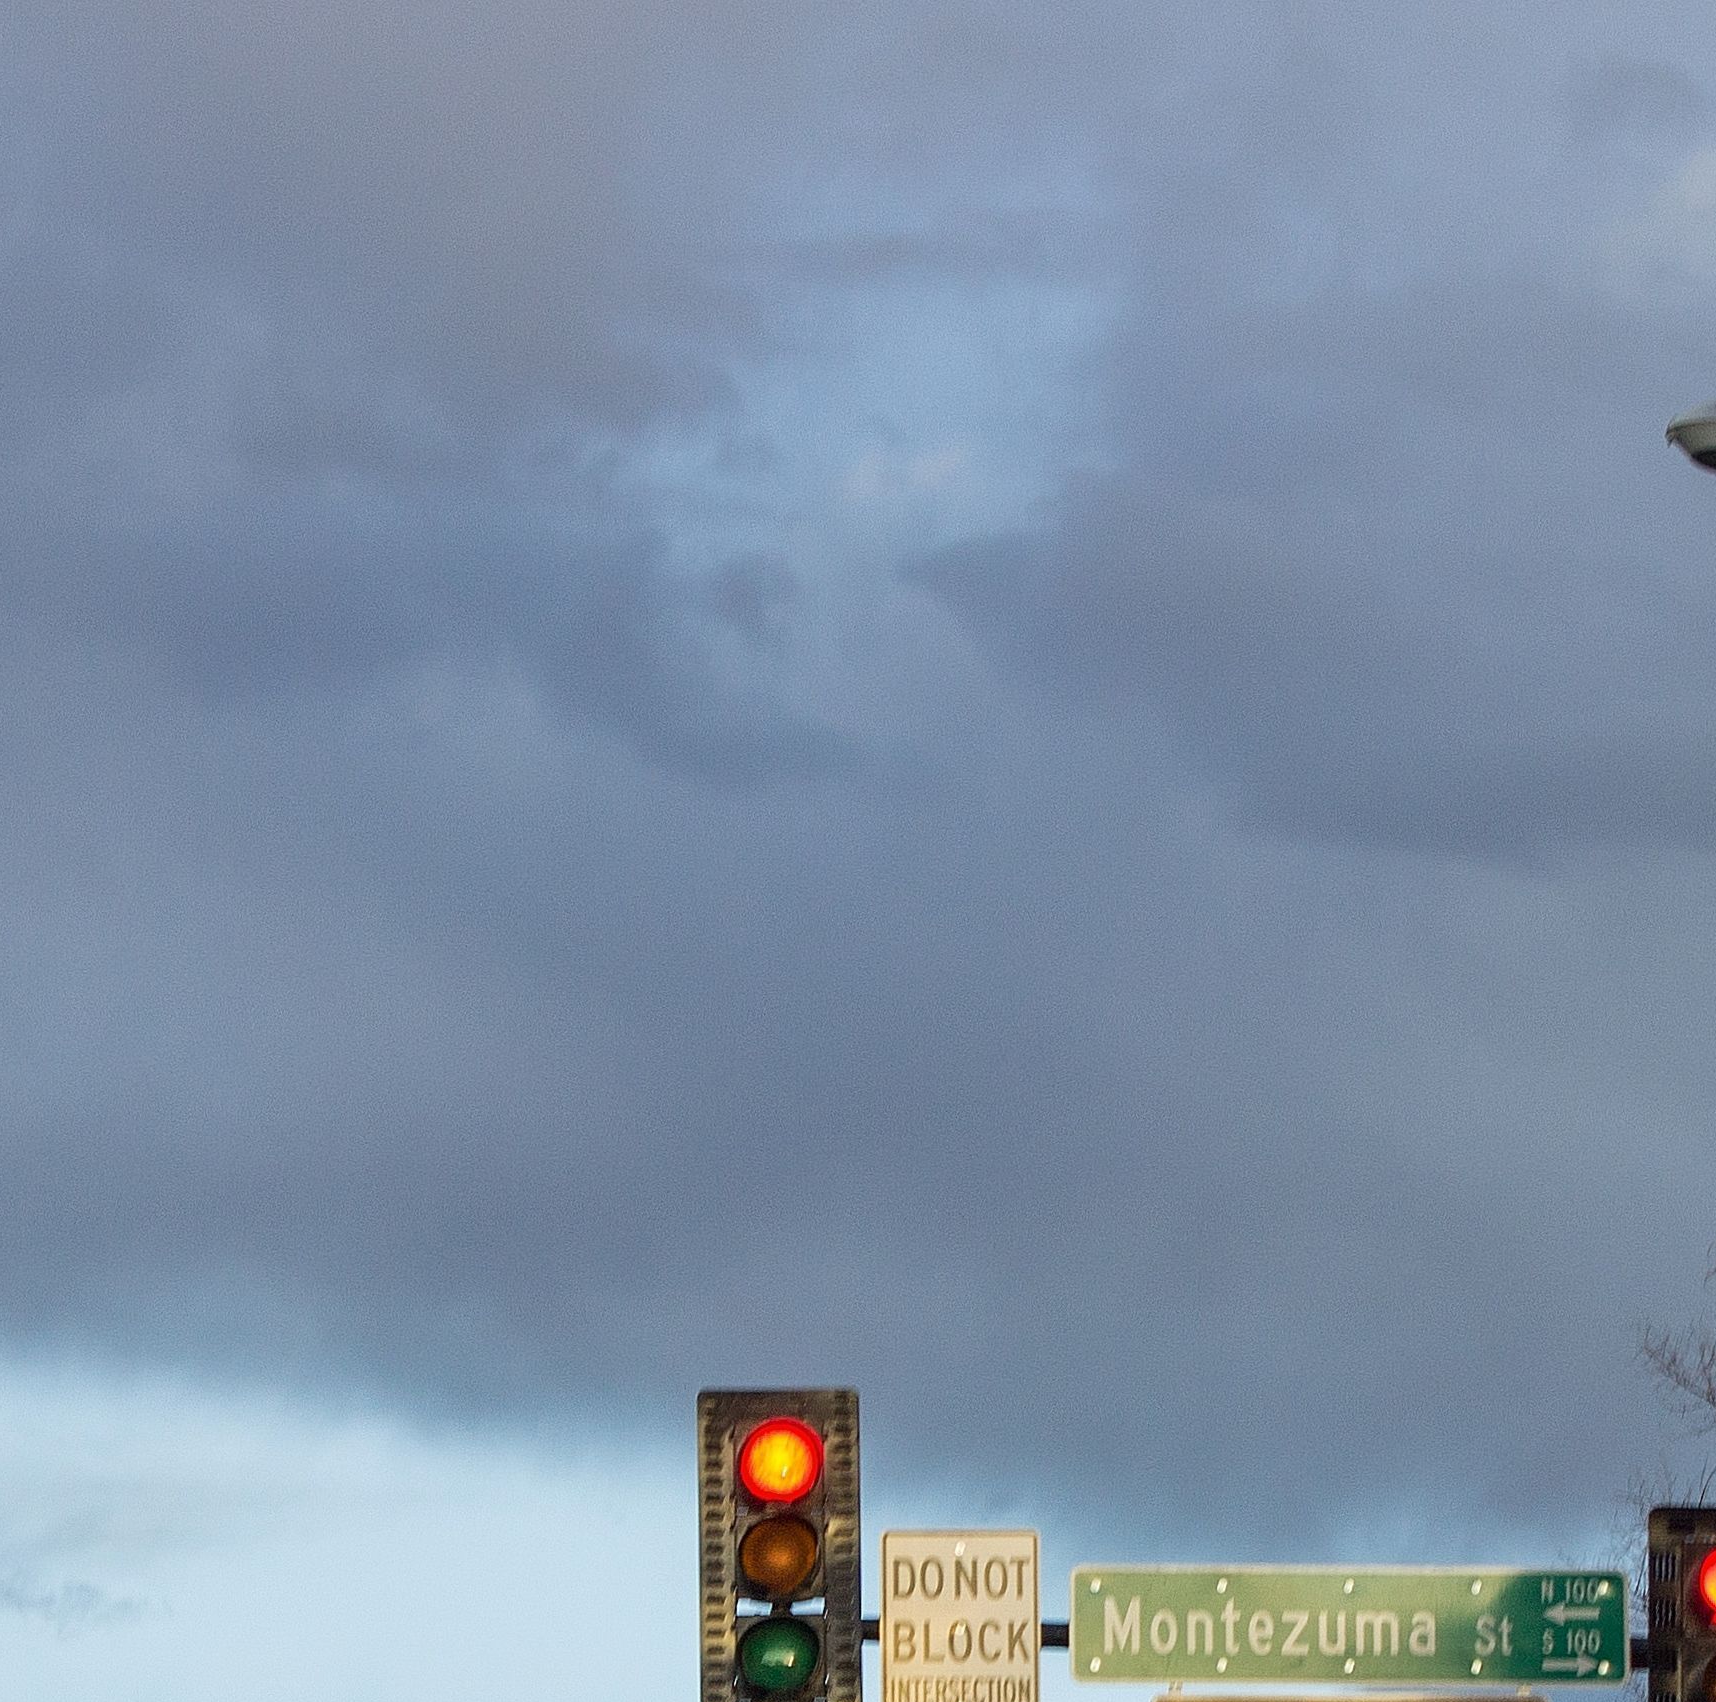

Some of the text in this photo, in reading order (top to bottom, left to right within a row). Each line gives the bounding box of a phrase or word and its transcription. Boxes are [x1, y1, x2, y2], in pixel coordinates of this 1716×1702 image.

[892, 1555, 1031, 1600] DO NOT
[1541, 1578, 1601, 1604] N 100
[892, 1618, 1030, 1664] BLOCK
[1102, 1594, 1514, 1658] Montezuma St
[1542, 1628, 1602, 1654] S 100
